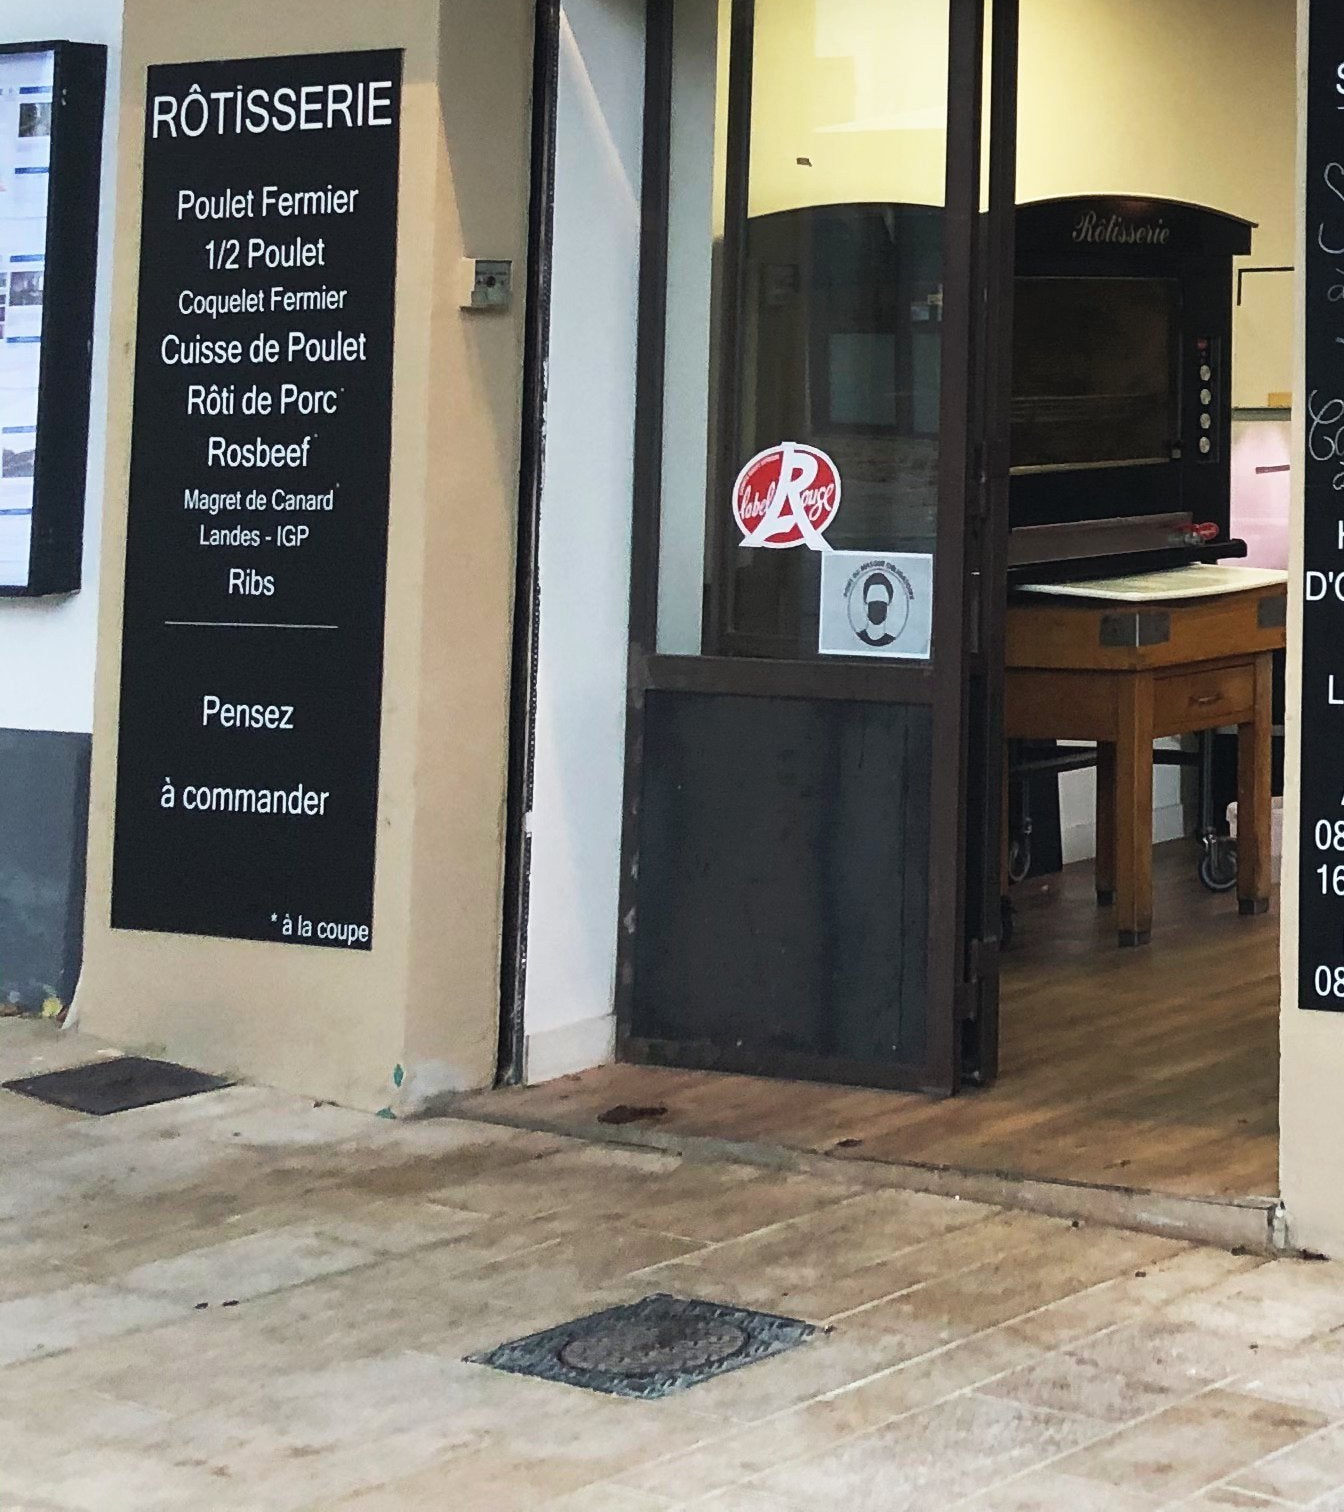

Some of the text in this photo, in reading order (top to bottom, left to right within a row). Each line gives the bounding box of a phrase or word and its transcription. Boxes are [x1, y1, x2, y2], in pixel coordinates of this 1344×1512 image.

[178, 185, 359, 219] Poulet Fermier
[1072, 210, 1170, 244] Rôtisserie
[206, 237, 324, 269] 1/2 Poulet
[179, 285, 347, 319] Coquelet Fermier
[162, 331, 366, 364] Cuisse de Poulet
[188, 384, 337, 415] Rôti de Porc
[208, 436, 310, 467] Rosbeef
[185, 489, 333, 515] Magret de Canard
[200, 525, 260, 546] Landes
[277, 526, 309, 546] IGP
[229, 568, 274, 595] Ribs
[203, 696, 293, 728] Pensez
[161, 777, 329, 815] à commander
[283, 914, 369, 945] à la coupe
